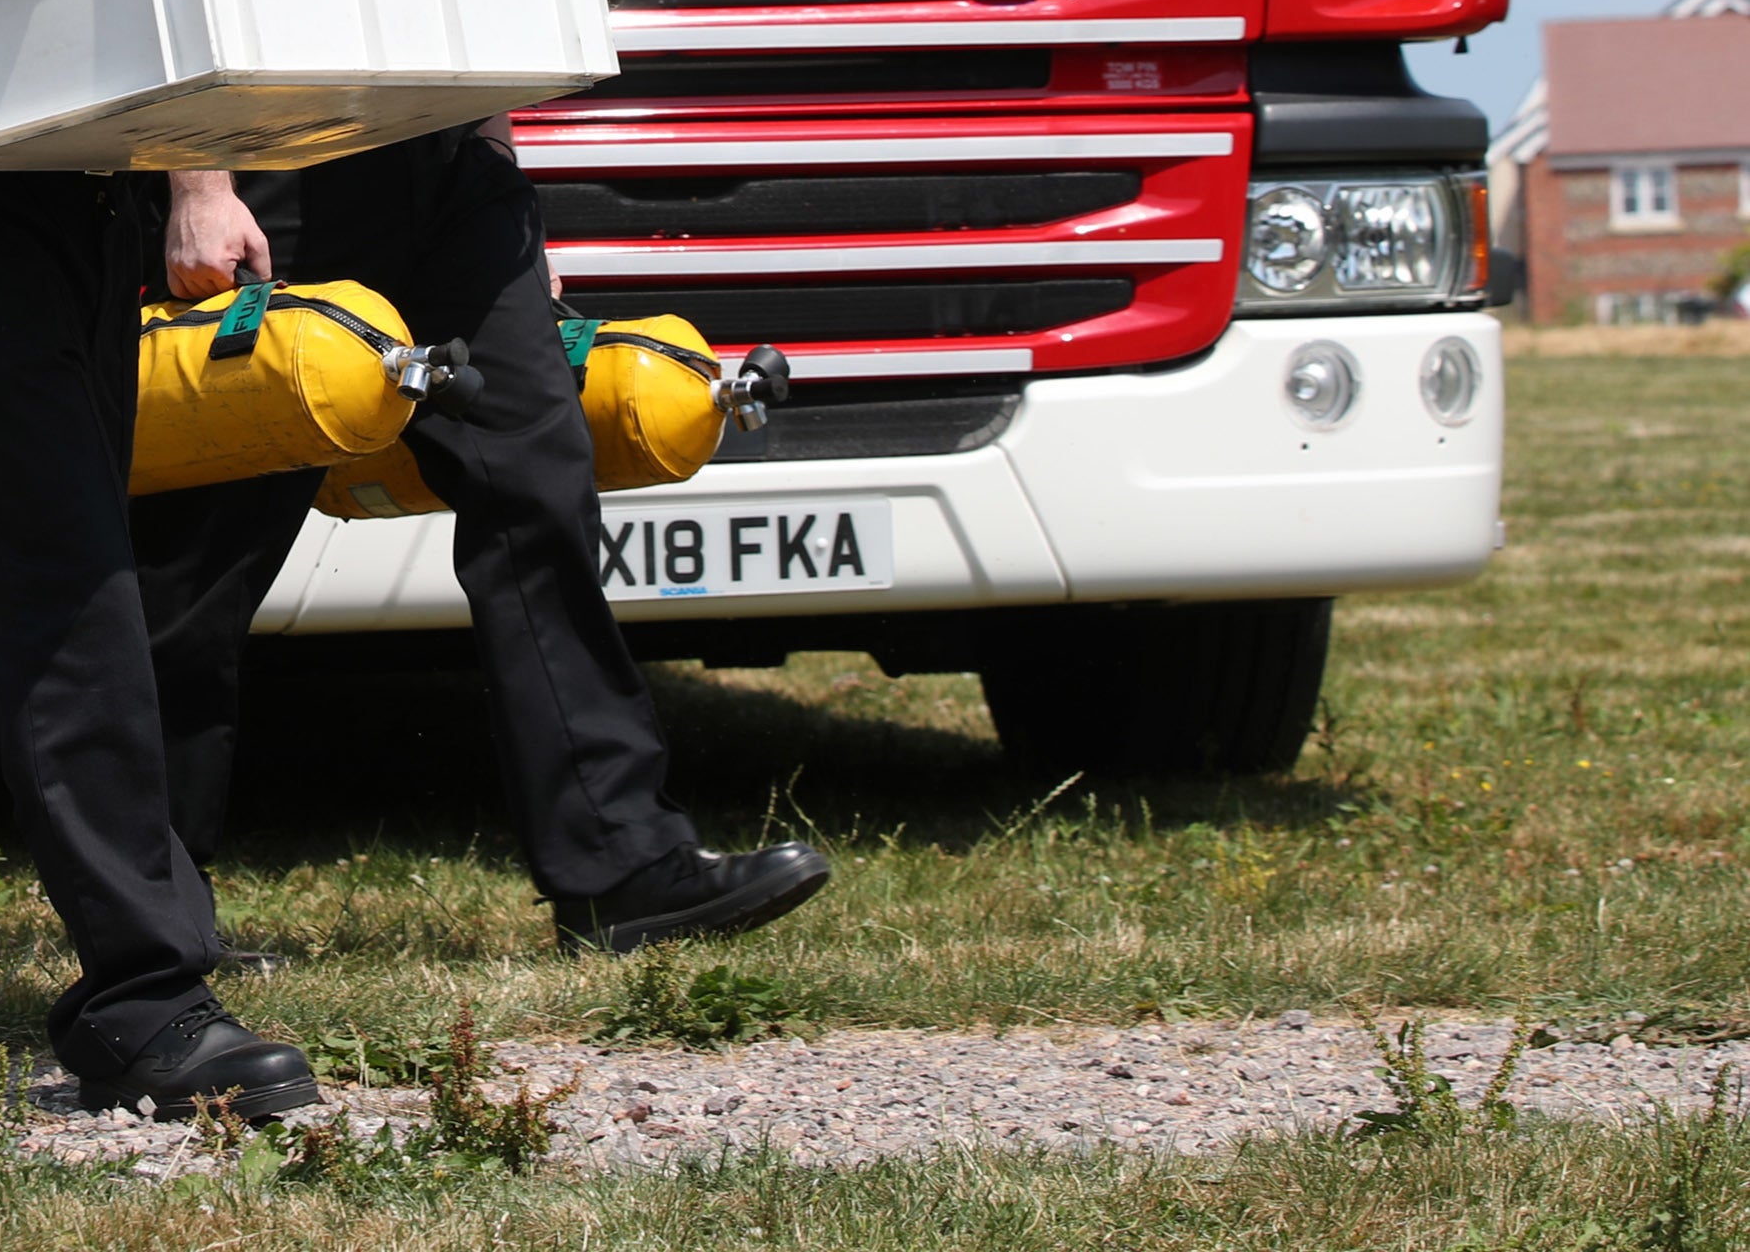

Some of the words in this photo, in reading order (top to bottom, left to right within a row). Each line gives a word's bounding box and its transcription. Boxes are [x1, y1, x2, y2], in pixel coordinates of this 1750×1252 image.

[562, 319, 588, 352] ULL
[730, 511, 865, 582] FKA
[660, 586, 709, 597] SCANIA
